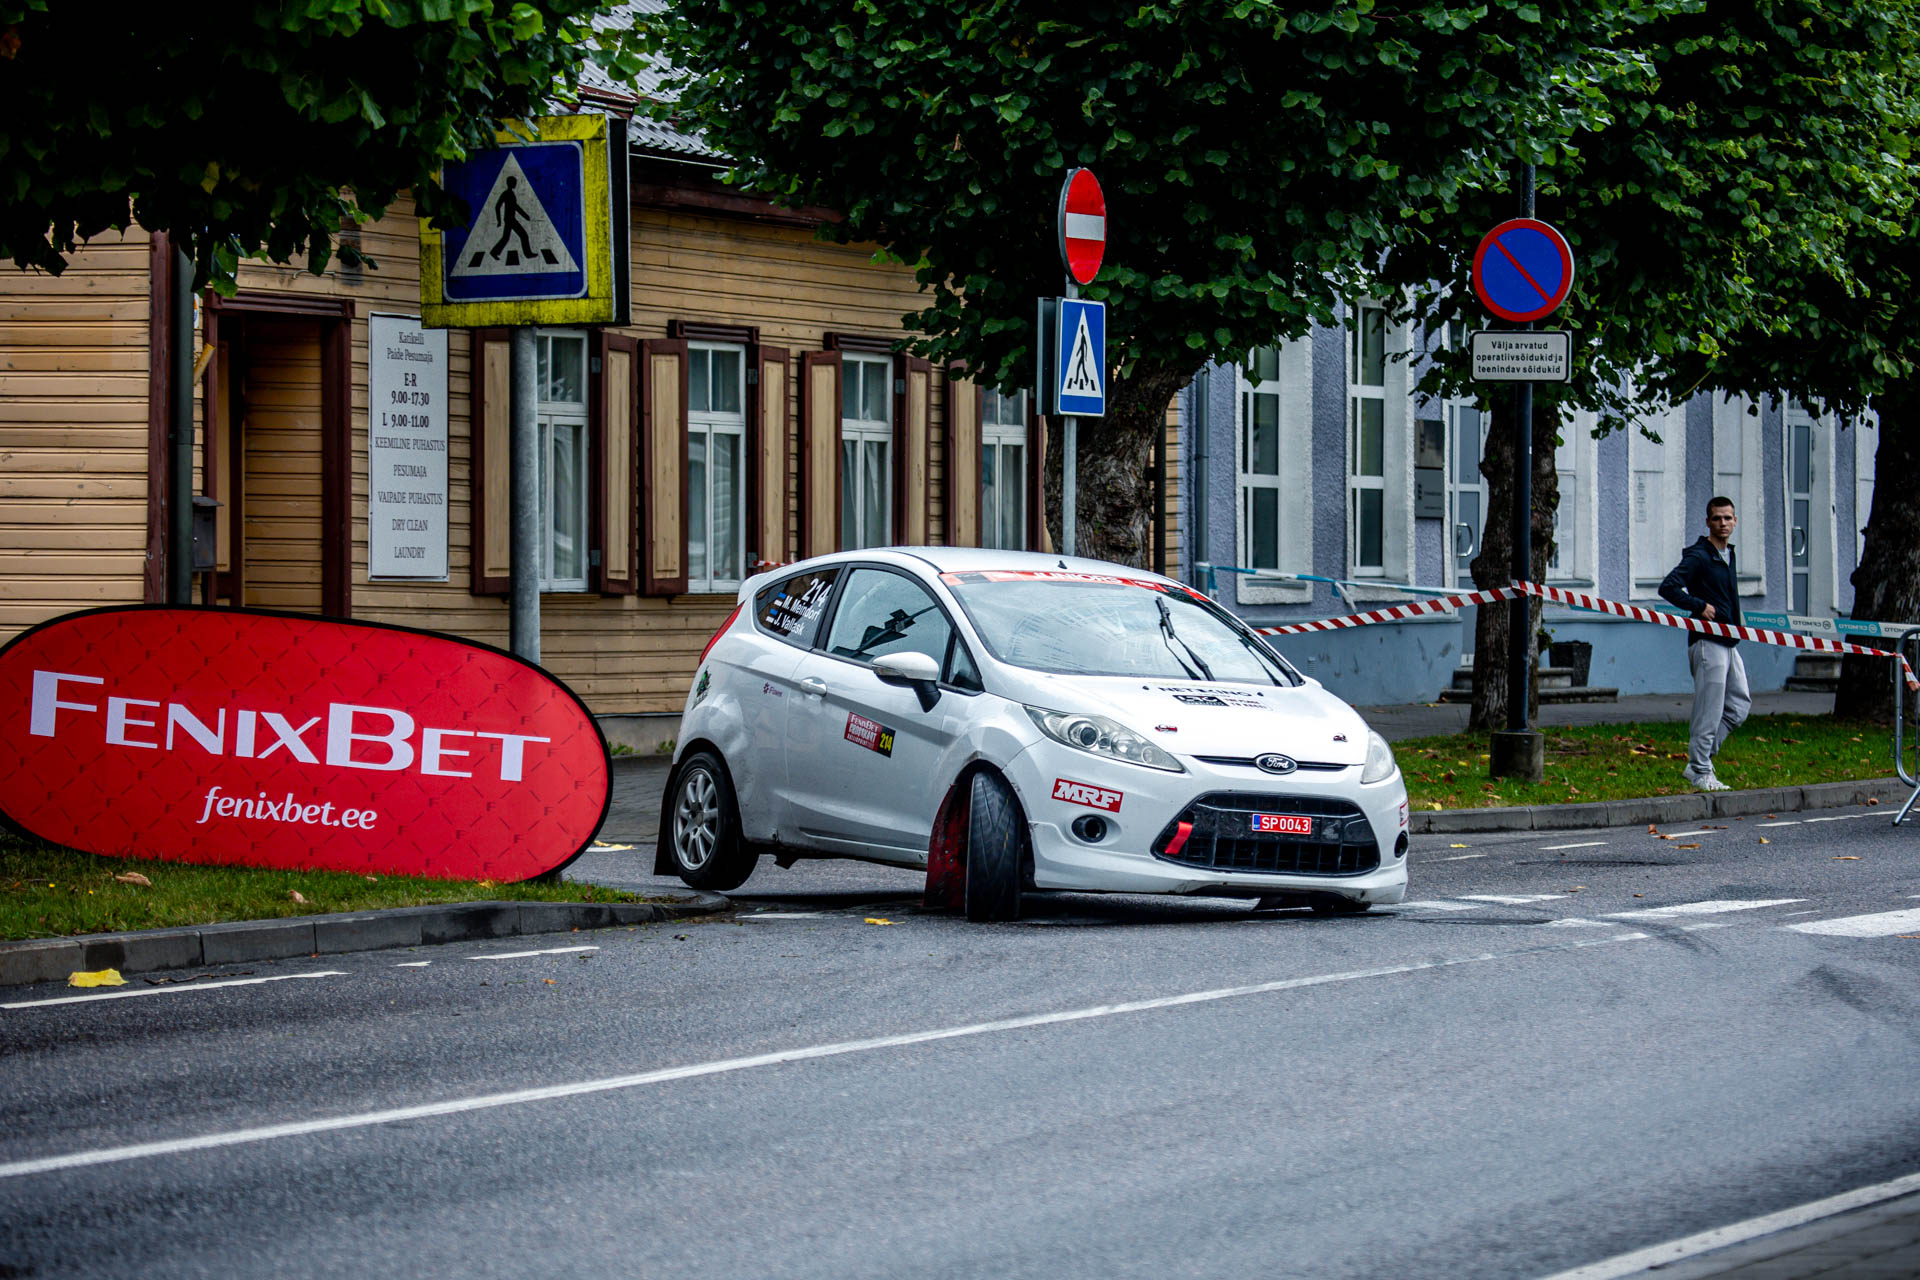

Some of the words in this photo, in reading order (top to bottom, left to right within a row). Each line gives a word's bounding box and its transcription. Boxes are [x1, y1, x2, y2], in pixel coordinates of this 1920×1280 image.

[1491, 341, 1513, 351] Välja
[387, 347, 404, 360] Paide
[1555, 354, 1563, 363] ja
[404, 373, 417, 387] E-R
[391, 390, 430, 406] 9.00-17.30
[382, 412, 388, 426] L
[391, 413, 430, 428] 9.00-11.00
[375, 437, 411, 449] KEEMILINE
[412, 439, 445, 451] PUHASTUS
[393, 464, 427, 478] PESUMAJA
[378, 491, 406, 503] VAIPADE
[408, 492, 443, 504] PUHASTUS
[392, 518, 406, 531] DRY
[407, 519, 428, 531] CLEAN
[394, 546, 425, 558] LAUNDRY
[801, 578, 832, 607] 214
[879, 732, 893, 751] 214
[1266, 757, 1289, 768] Ford
[1054, 781, 1121, 808] MRF
[196, 786, 377, 830] fenixbet.ee
[1261, 816, 1309, 832] SP0043
